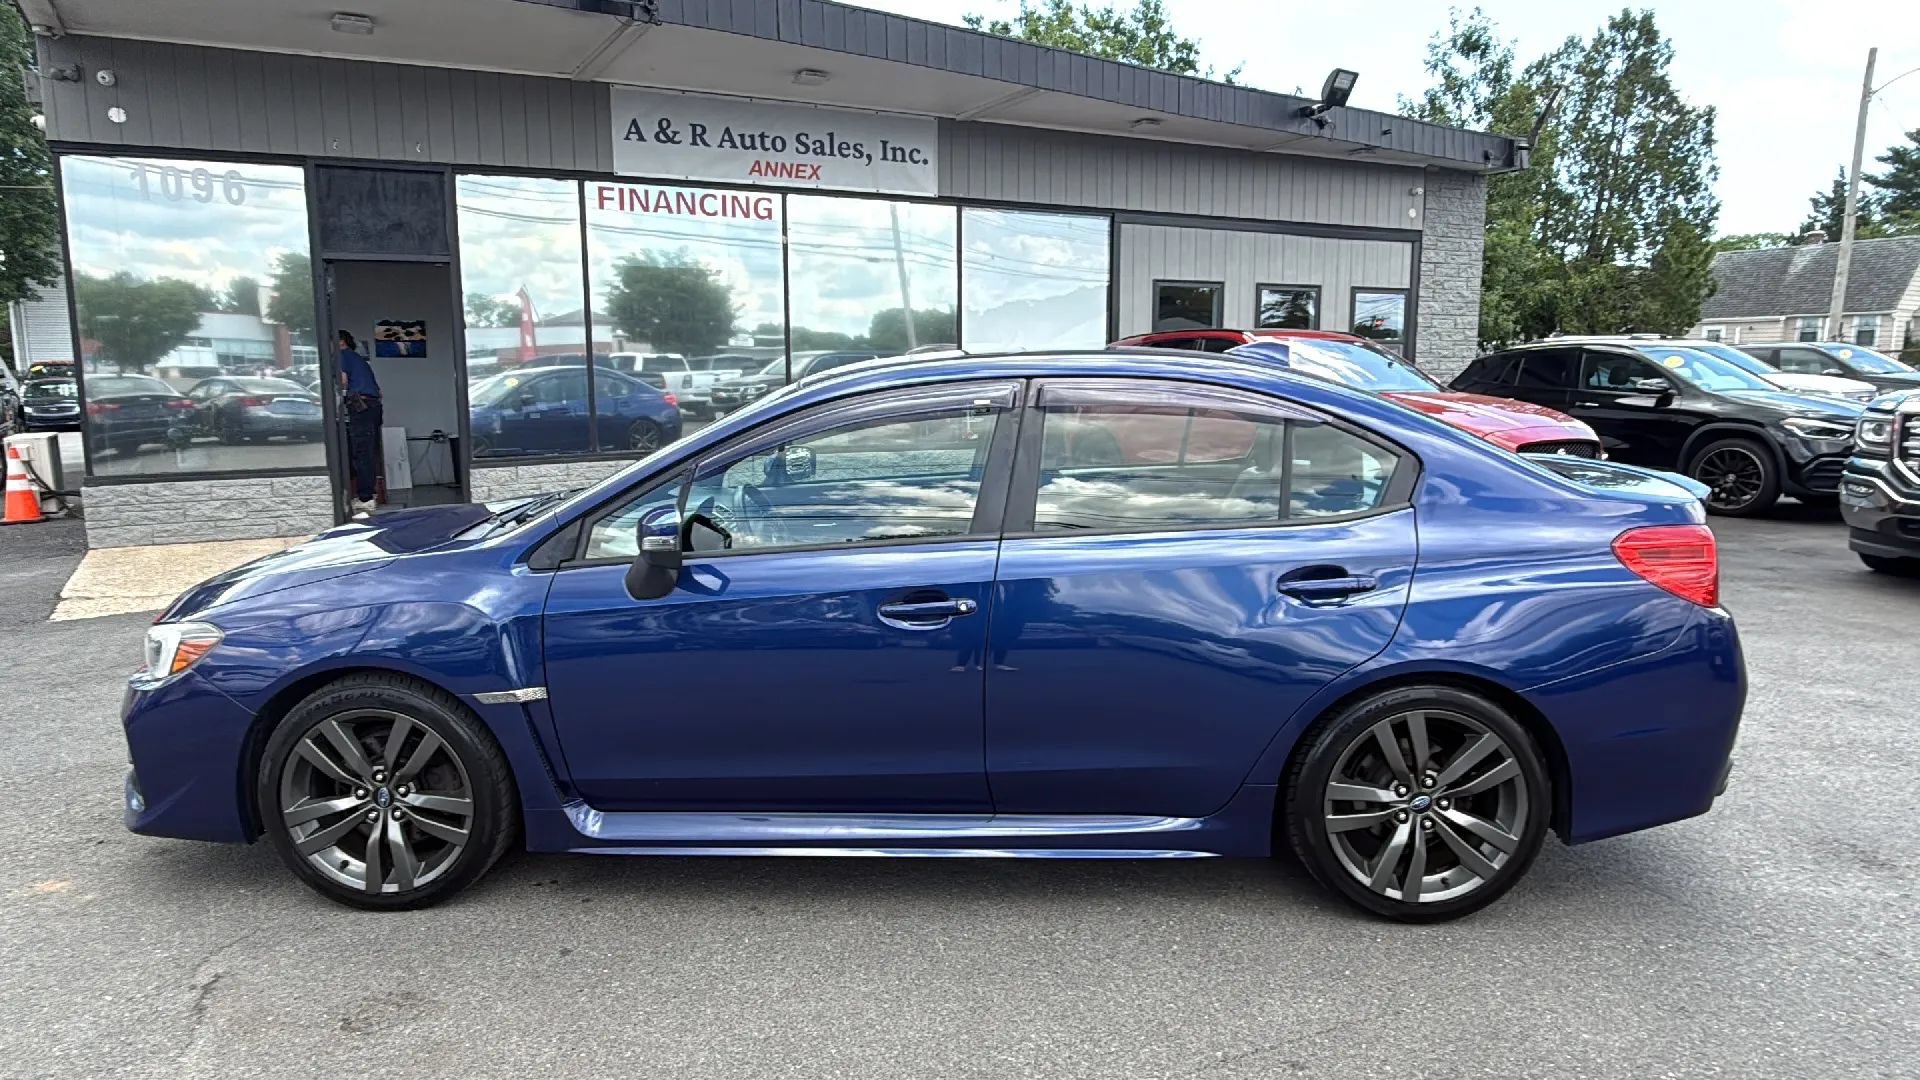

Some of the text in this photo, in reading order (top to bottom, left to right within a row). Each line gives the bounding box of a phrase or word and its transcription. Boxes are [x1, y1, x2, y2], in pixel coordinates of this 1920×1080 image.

[623, 117, 930, 166] A & R Auto Sales, Inc.
[130, 162, 246, 206] 1096
[748, 159, 823, 180] ANNEX
[597, 185, 774, 221] FINANCING
